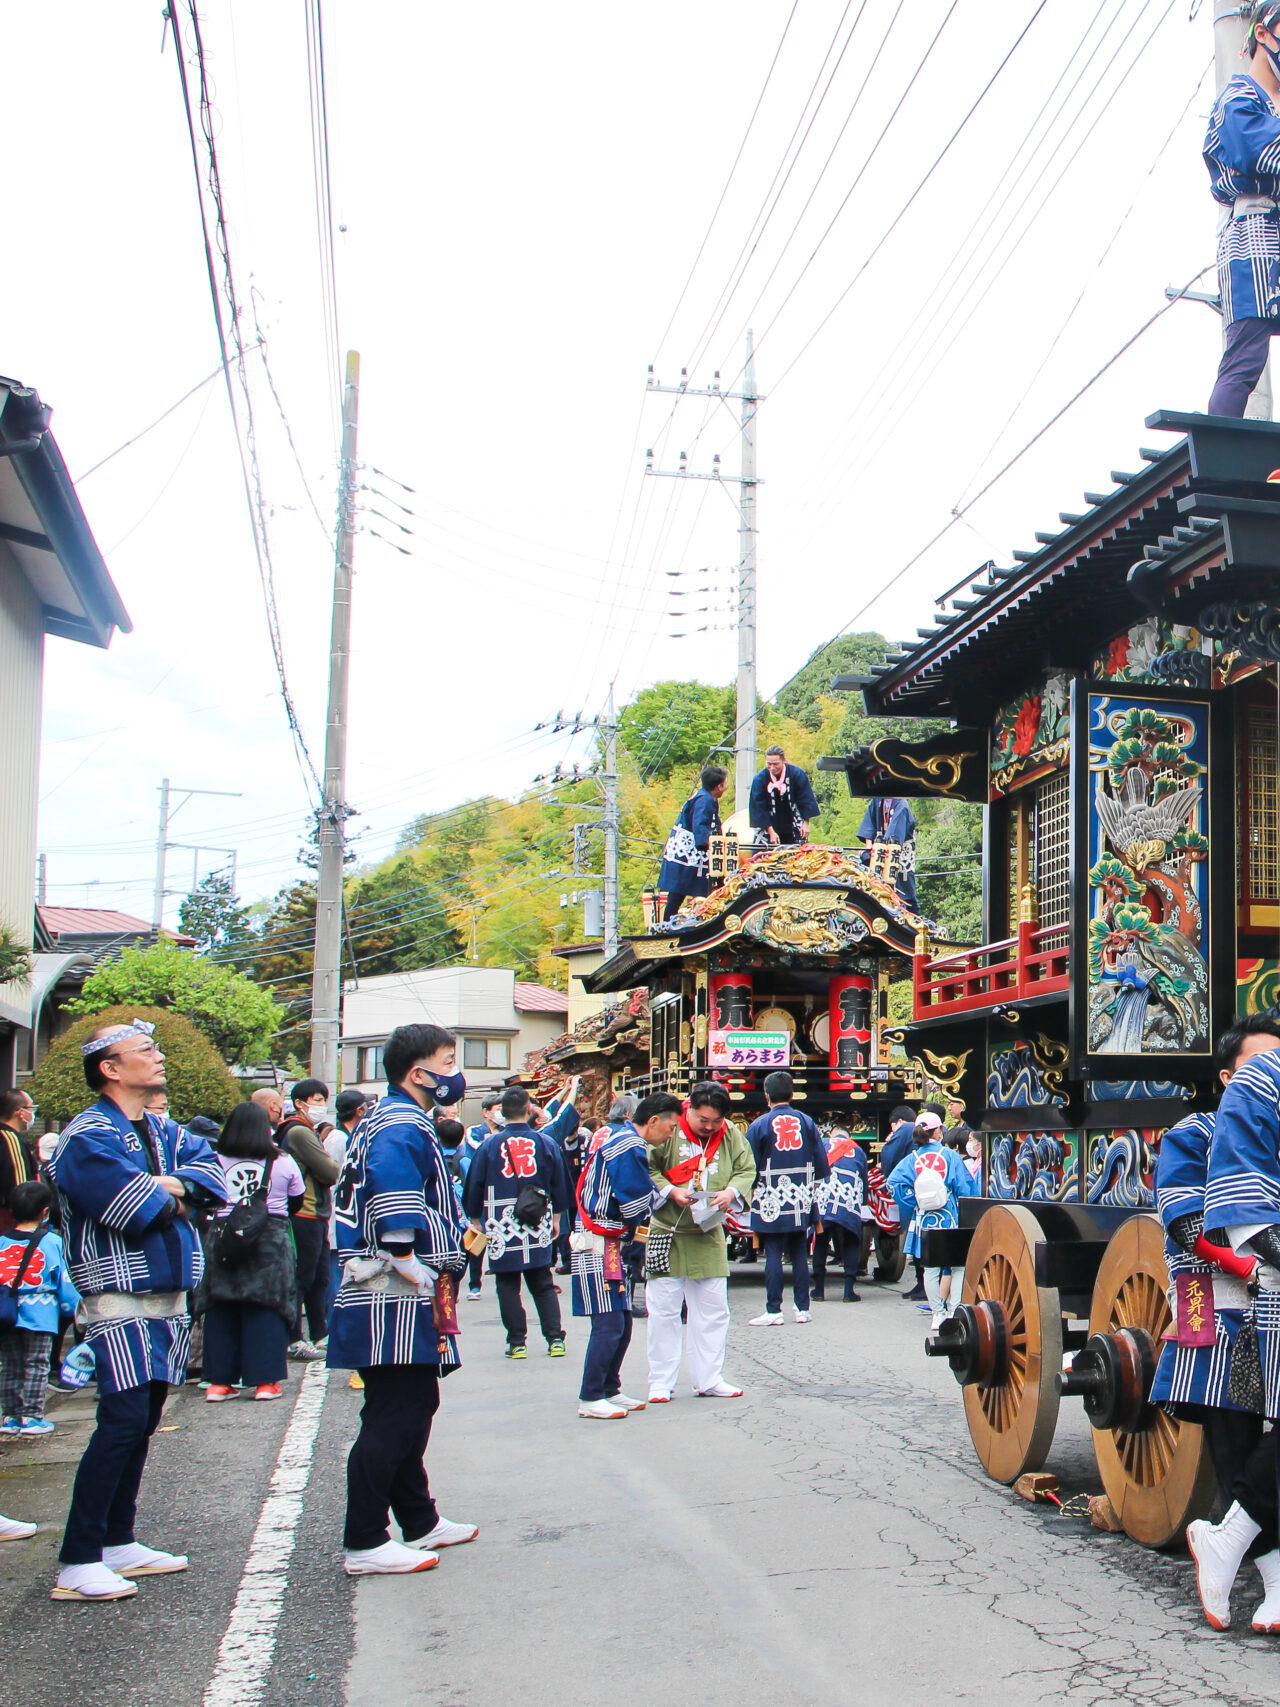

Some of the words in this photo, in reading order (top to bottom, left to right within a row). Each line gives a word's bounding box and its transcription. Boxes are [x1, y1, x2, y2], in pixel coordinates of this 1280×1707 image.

[712, 840, 724, 872] 荒町
[726, 841, 738, 871] 荒町
[889, 849, 900, 878] 荒町
[712, 1041, 727, 1055] 祝
[836, 986, 872, 1079] 荒町
[731, 1048, 786, 1063] あらまち
[771, 1114, 803, 1151] 荒
[501, 1136, 538, 1178] 荒
